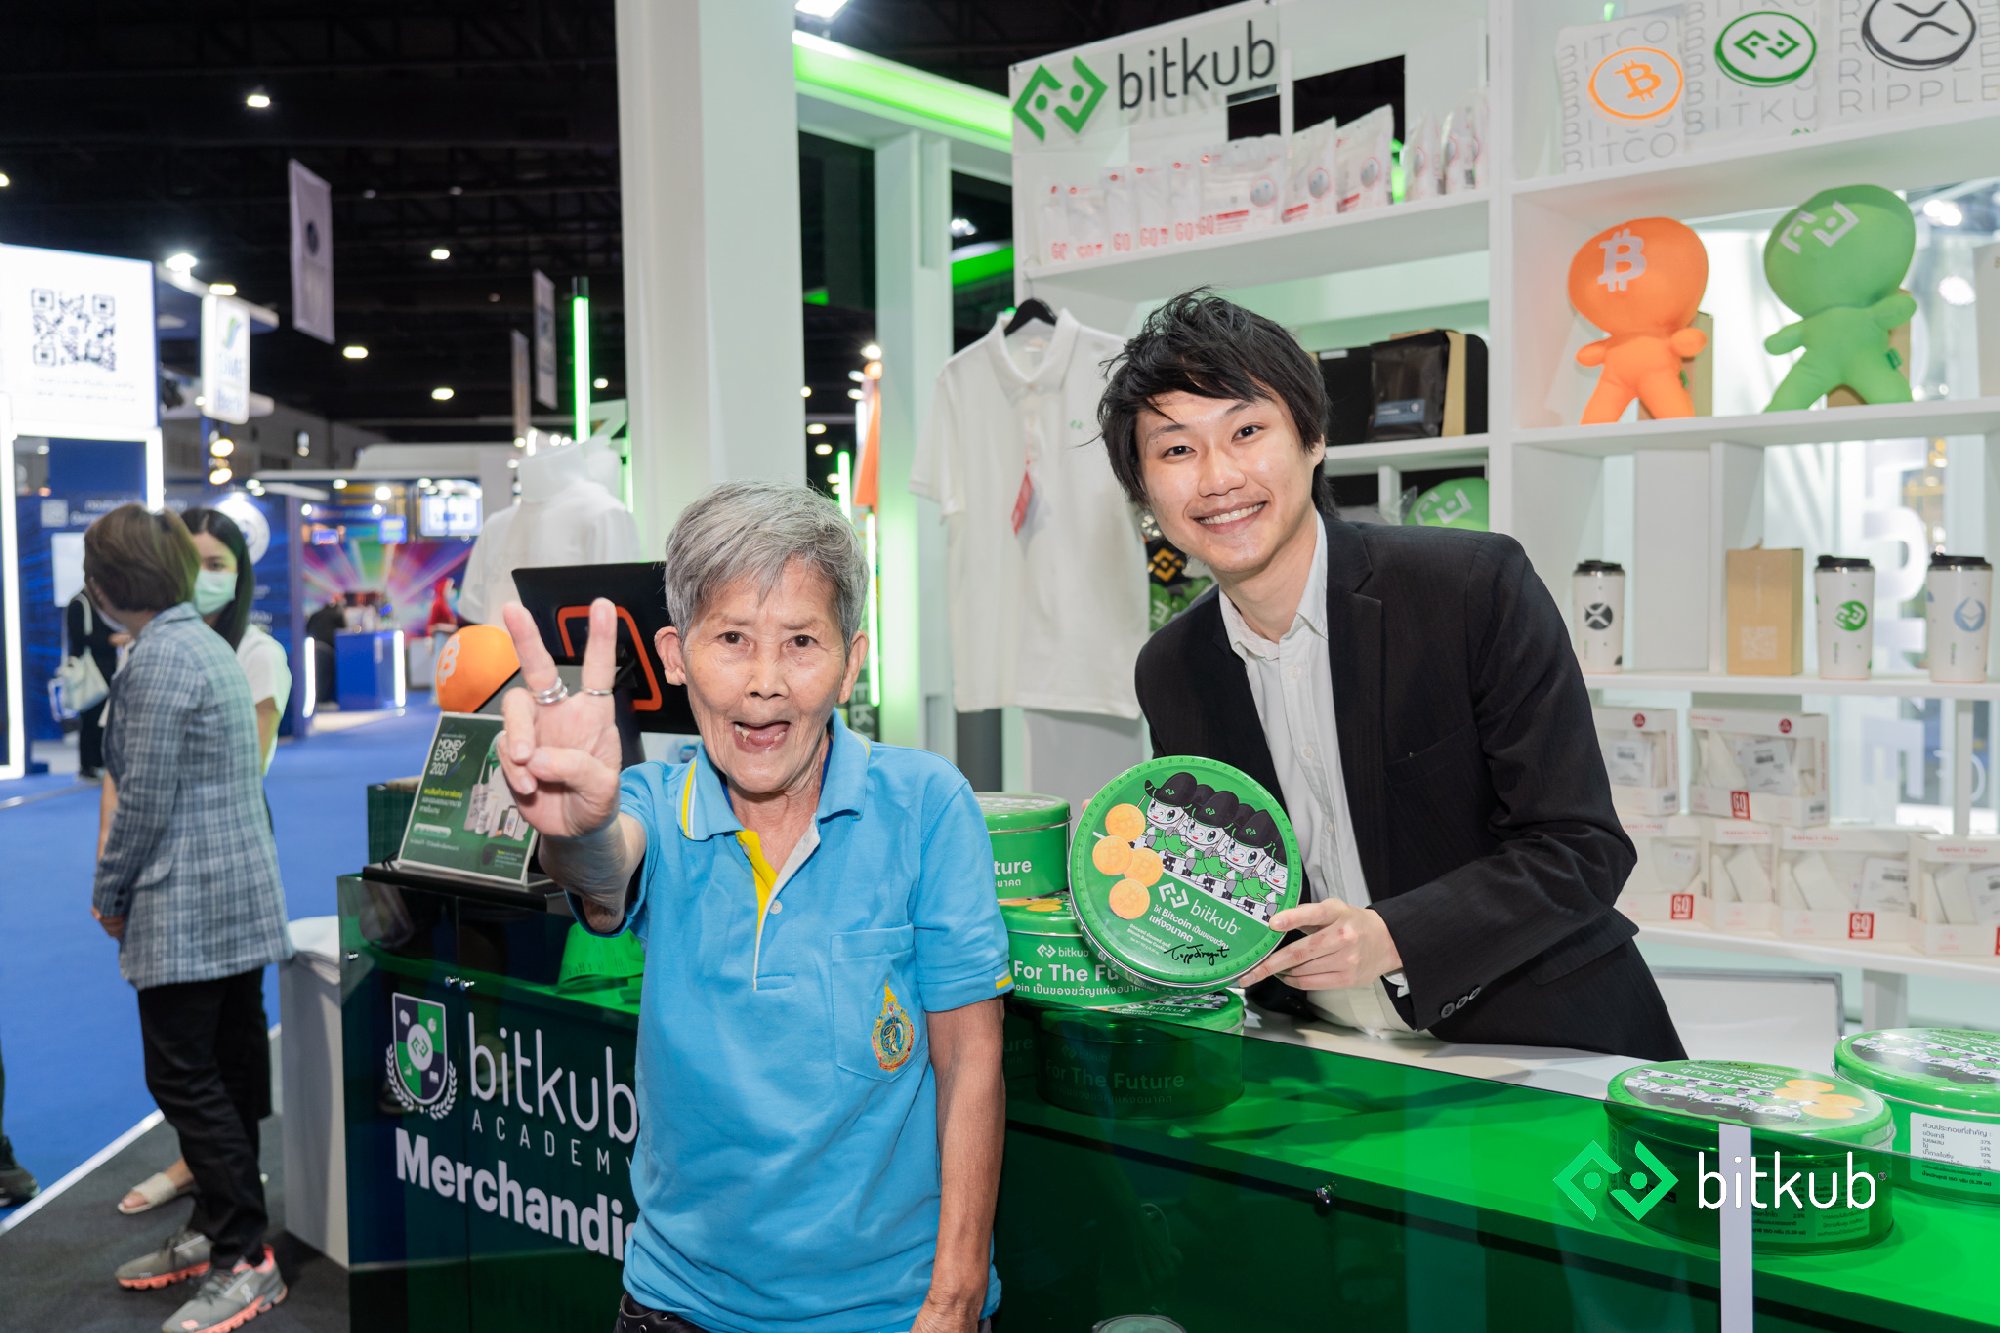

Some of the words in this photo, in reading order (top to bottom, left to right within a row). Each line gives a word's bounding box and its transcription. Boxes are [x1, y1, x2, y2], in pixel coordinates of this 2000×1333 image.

[1118, 20, 1276, 110] bitkub
[437, 739, 466, 751] MONEY
[433, 749, 458, 762] EXPO
[429, 762, 448, 776] 2021
[993, 860, 1032, 875] ture
[996, 878, 1021, 887] นาคต
[1162, 908, 1192, 930] Bitcoin
[1190, 899, 1238, 935] bitkub
[1058, 946, 1089, 958] bitkub
[1013, 960, 1042, 980] For
[1048, 964, 1088, 982] The
[1095, 964, 1119, 981] Fu
[1014, 984, 1030, 992] oin
[1003, 1037, 1033, 1051] ure
[468, 1011, 638, 1144] bitkub
[1071, 1067, 1107, 1087] The
[1114, 1073, 1185, 1090] Future
